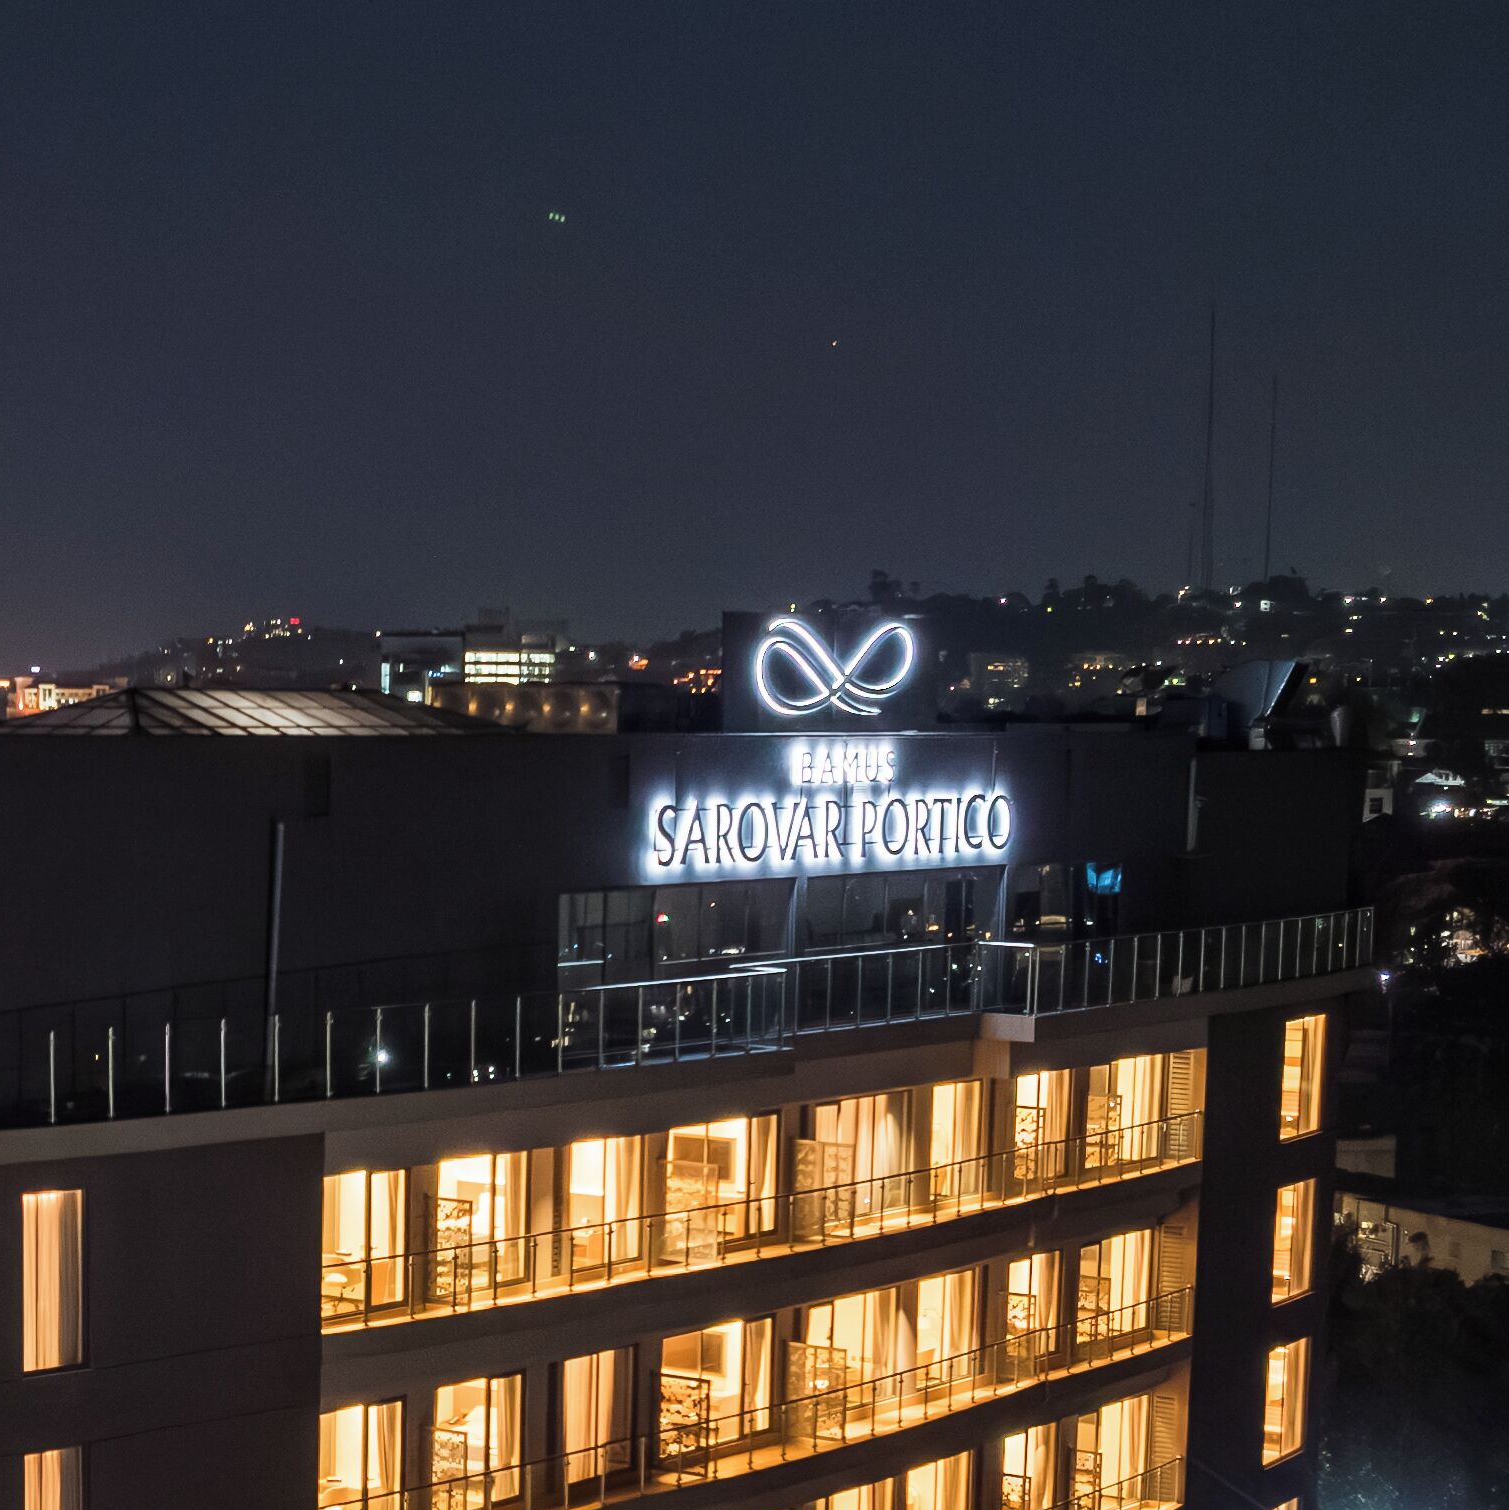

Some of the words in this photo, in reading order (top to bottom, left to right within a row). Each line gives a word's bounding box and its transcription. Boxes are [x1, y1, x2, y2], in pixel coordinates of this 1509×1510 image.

[801, 750, 896, 783] BAMUS
[656, 800, 844, 867] SAROVAR
[861, 794, 1012, 858] PORTICO
